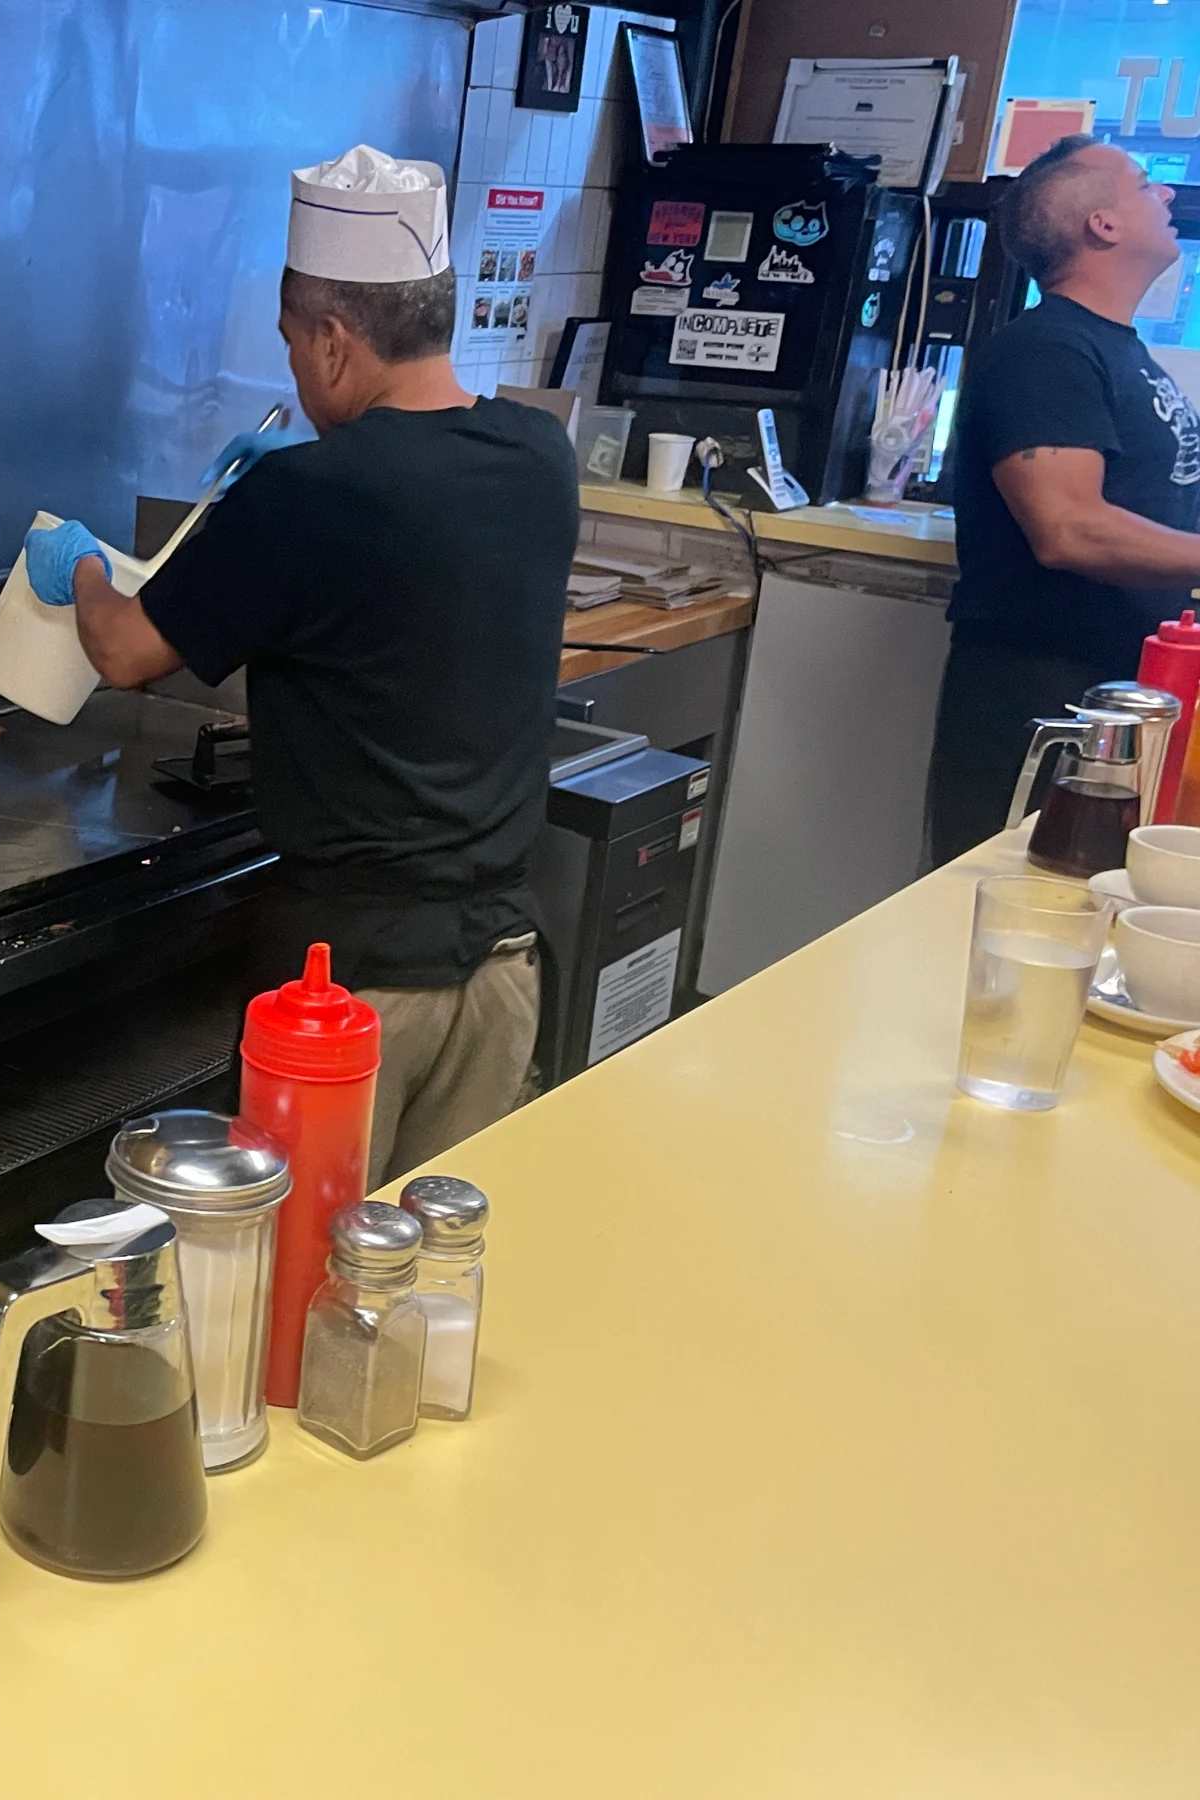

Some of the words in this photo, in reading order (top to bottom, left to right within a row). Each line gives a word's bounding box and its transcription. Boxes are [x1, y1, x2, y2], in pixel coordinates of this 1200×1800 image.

[649, 231, 669, 243] NEW
[672, 232, 699, 245] YORK
[678, 314, 779, 337] INCOMPLETE
